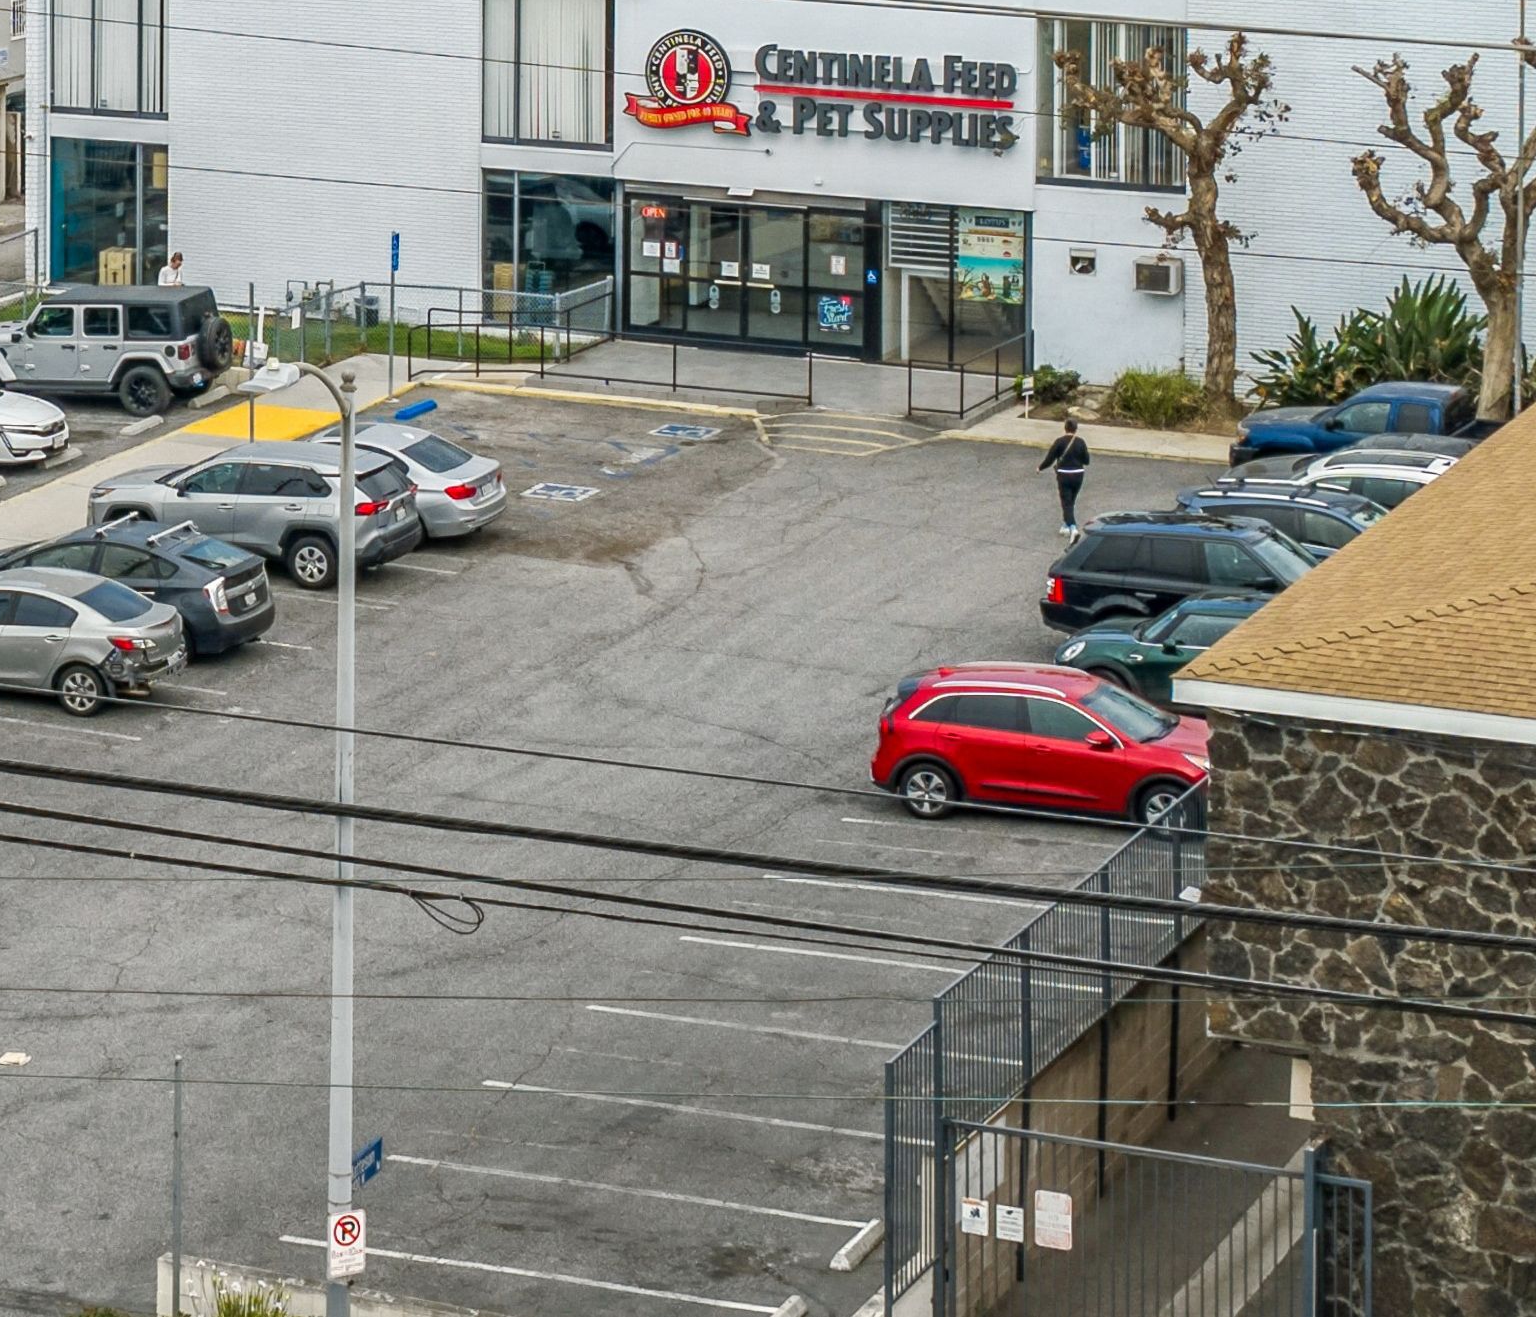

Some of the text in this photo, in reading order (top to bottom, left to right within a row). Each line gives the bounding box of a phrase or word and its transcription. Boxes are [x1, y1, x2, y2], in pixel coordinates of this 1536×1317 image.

[652, 34, 723, 70] CENTINELA FEED
[755, 44, 1017, 98] CENTINELA FEED
[756, 96, 1017, 150] & PET SUPPLIES
[642, 207, 666, 218] OPEN
